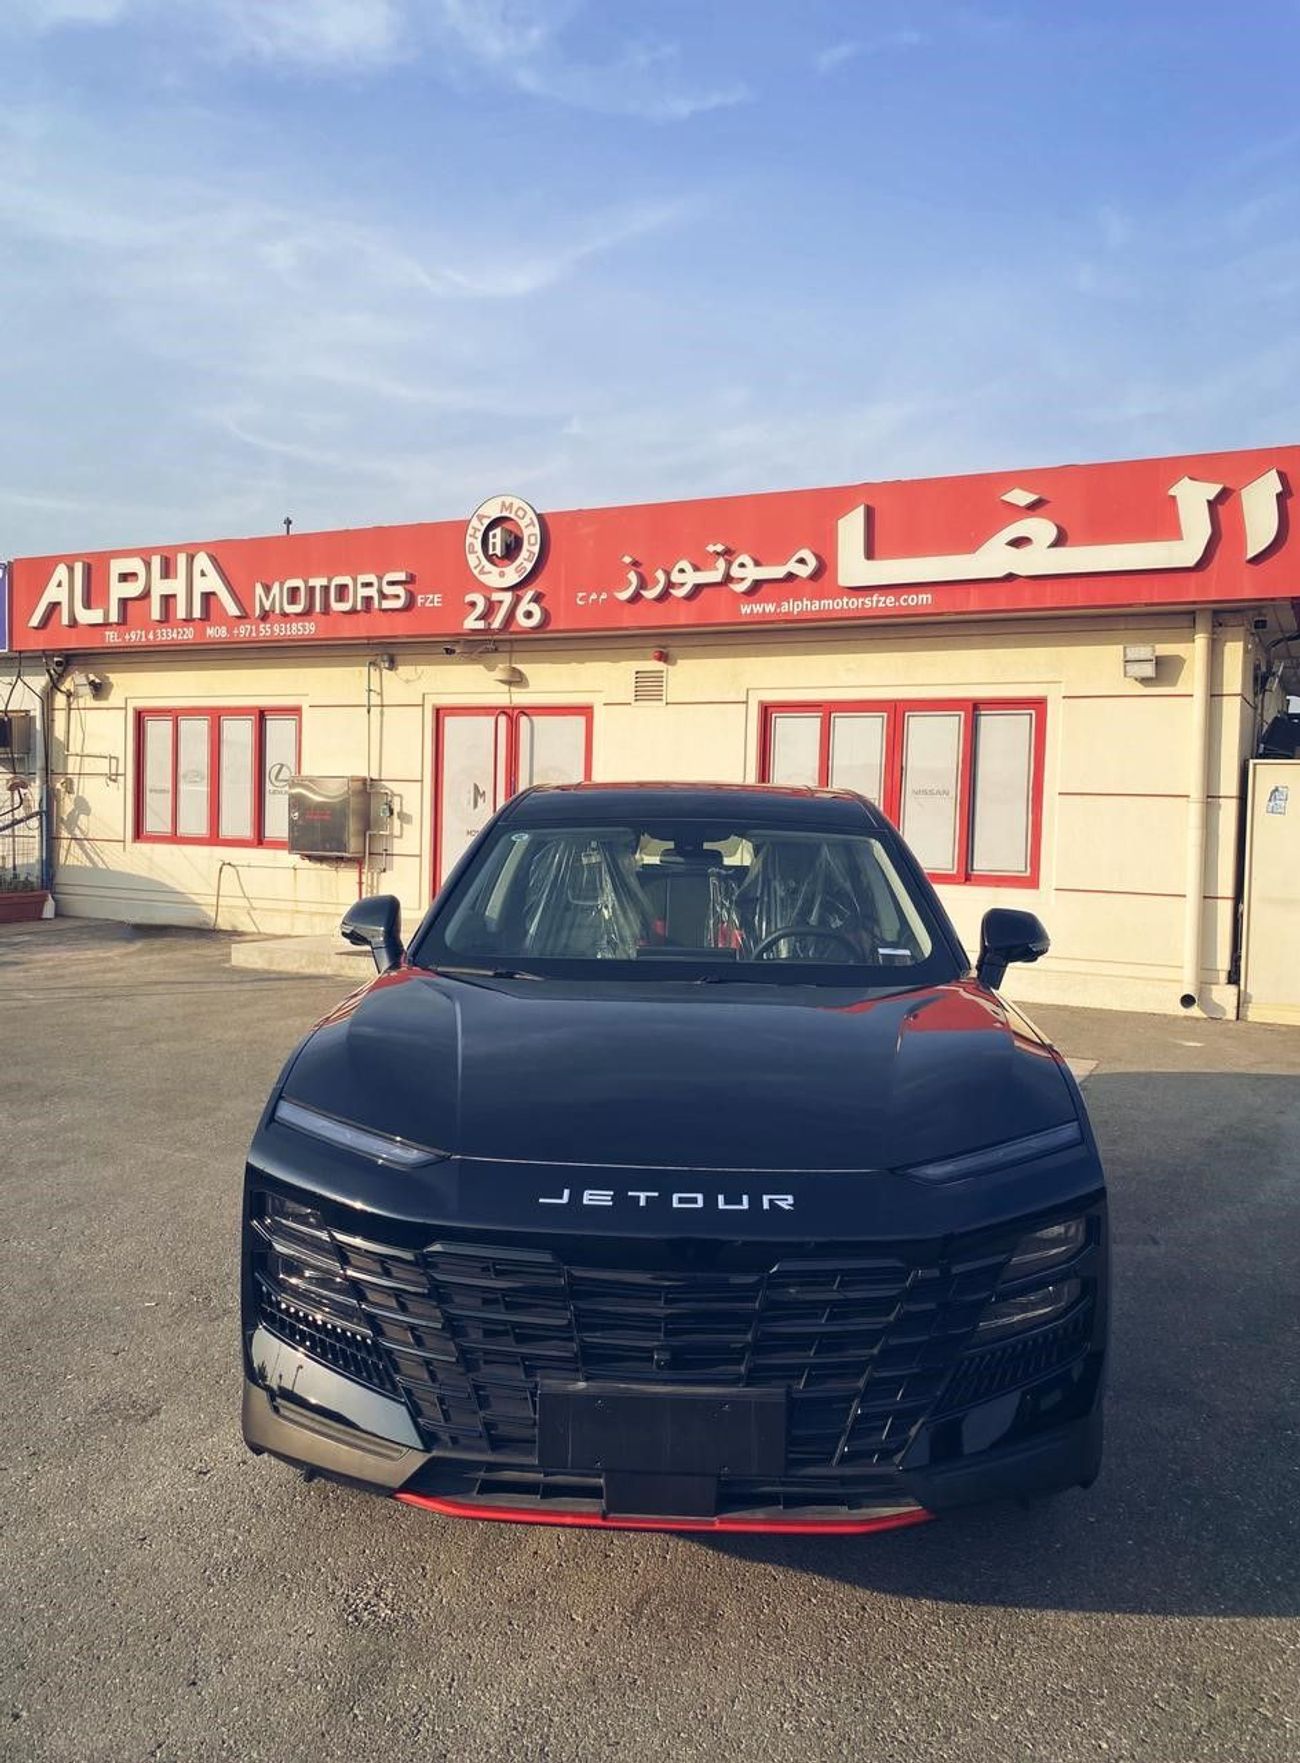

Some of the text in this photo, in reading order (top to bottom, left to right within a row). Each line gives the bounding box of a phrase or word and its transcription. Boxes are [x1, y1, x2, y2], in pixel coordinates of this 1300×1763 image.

[467, 500, 540, 578] ALPHA MOTORS
[613, 542, 818, 602] موتورز
[28, 550, 443, 628] ALPHA MOTORS FZE
[739, 592, 933, 616] www.alphamotorsfze.com
[463, 590, 542, 630] 276
[104, 626, 194, 643] TEL. +971 4 3334220
[206, 621, 316, 638] MOB. +971 55 9318539
[538, 1188, 795, 1210] JETOUR
